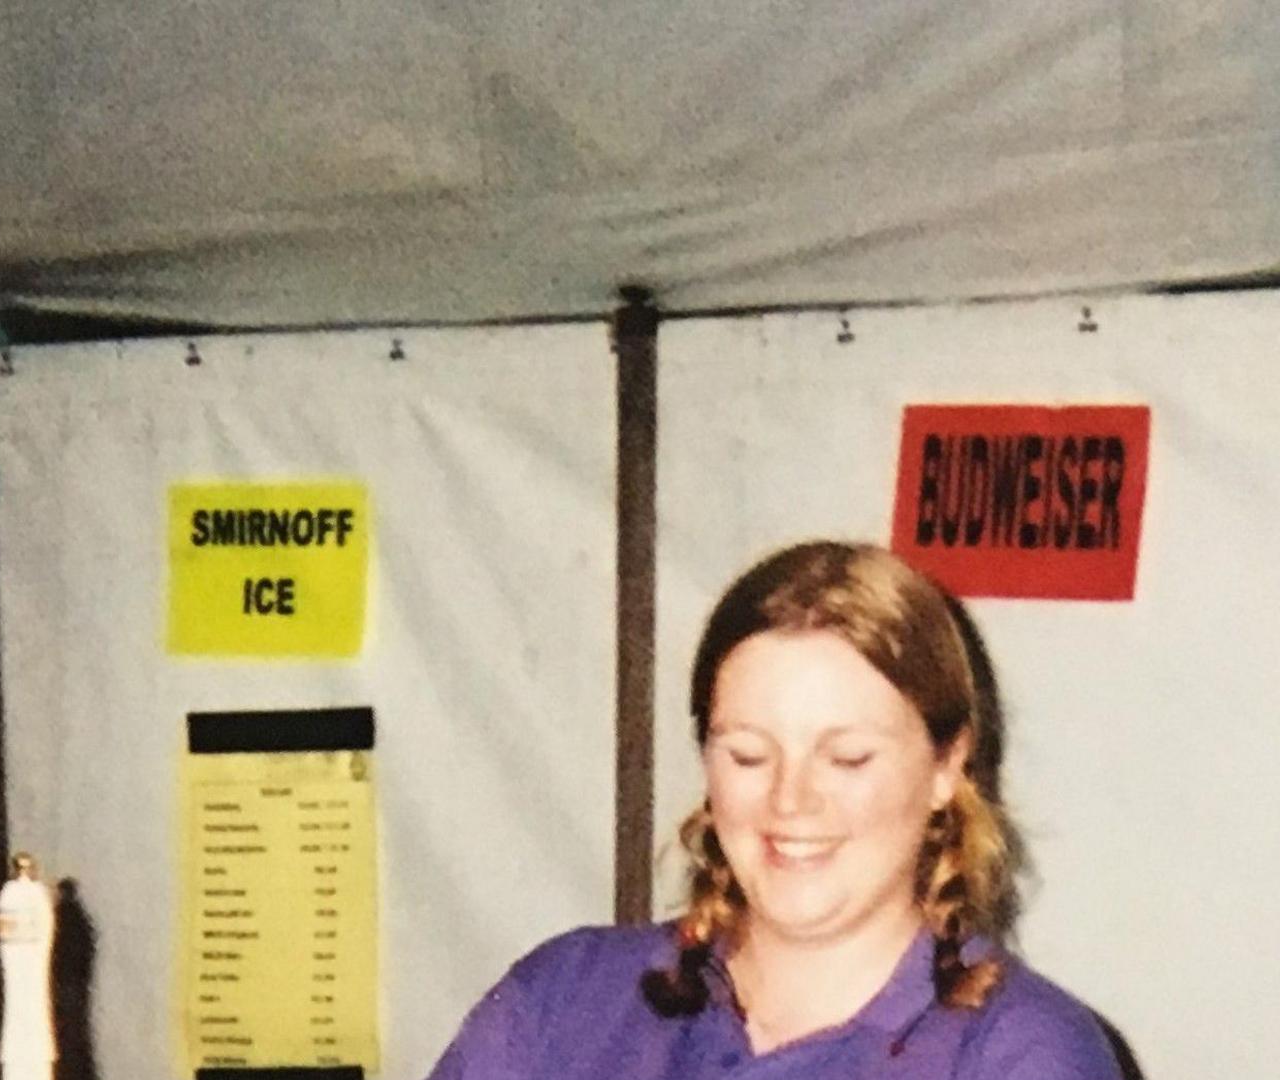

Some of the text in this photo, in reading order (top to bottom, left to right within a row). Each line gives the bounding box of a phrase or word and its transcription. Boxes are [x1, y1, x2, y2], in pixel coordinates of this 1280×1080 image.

[917, 433, 1124, 549] BUDWEISER
[190, 508, 354, 547] SMIRNOFF
[242, 577, 296, 616] ICE
